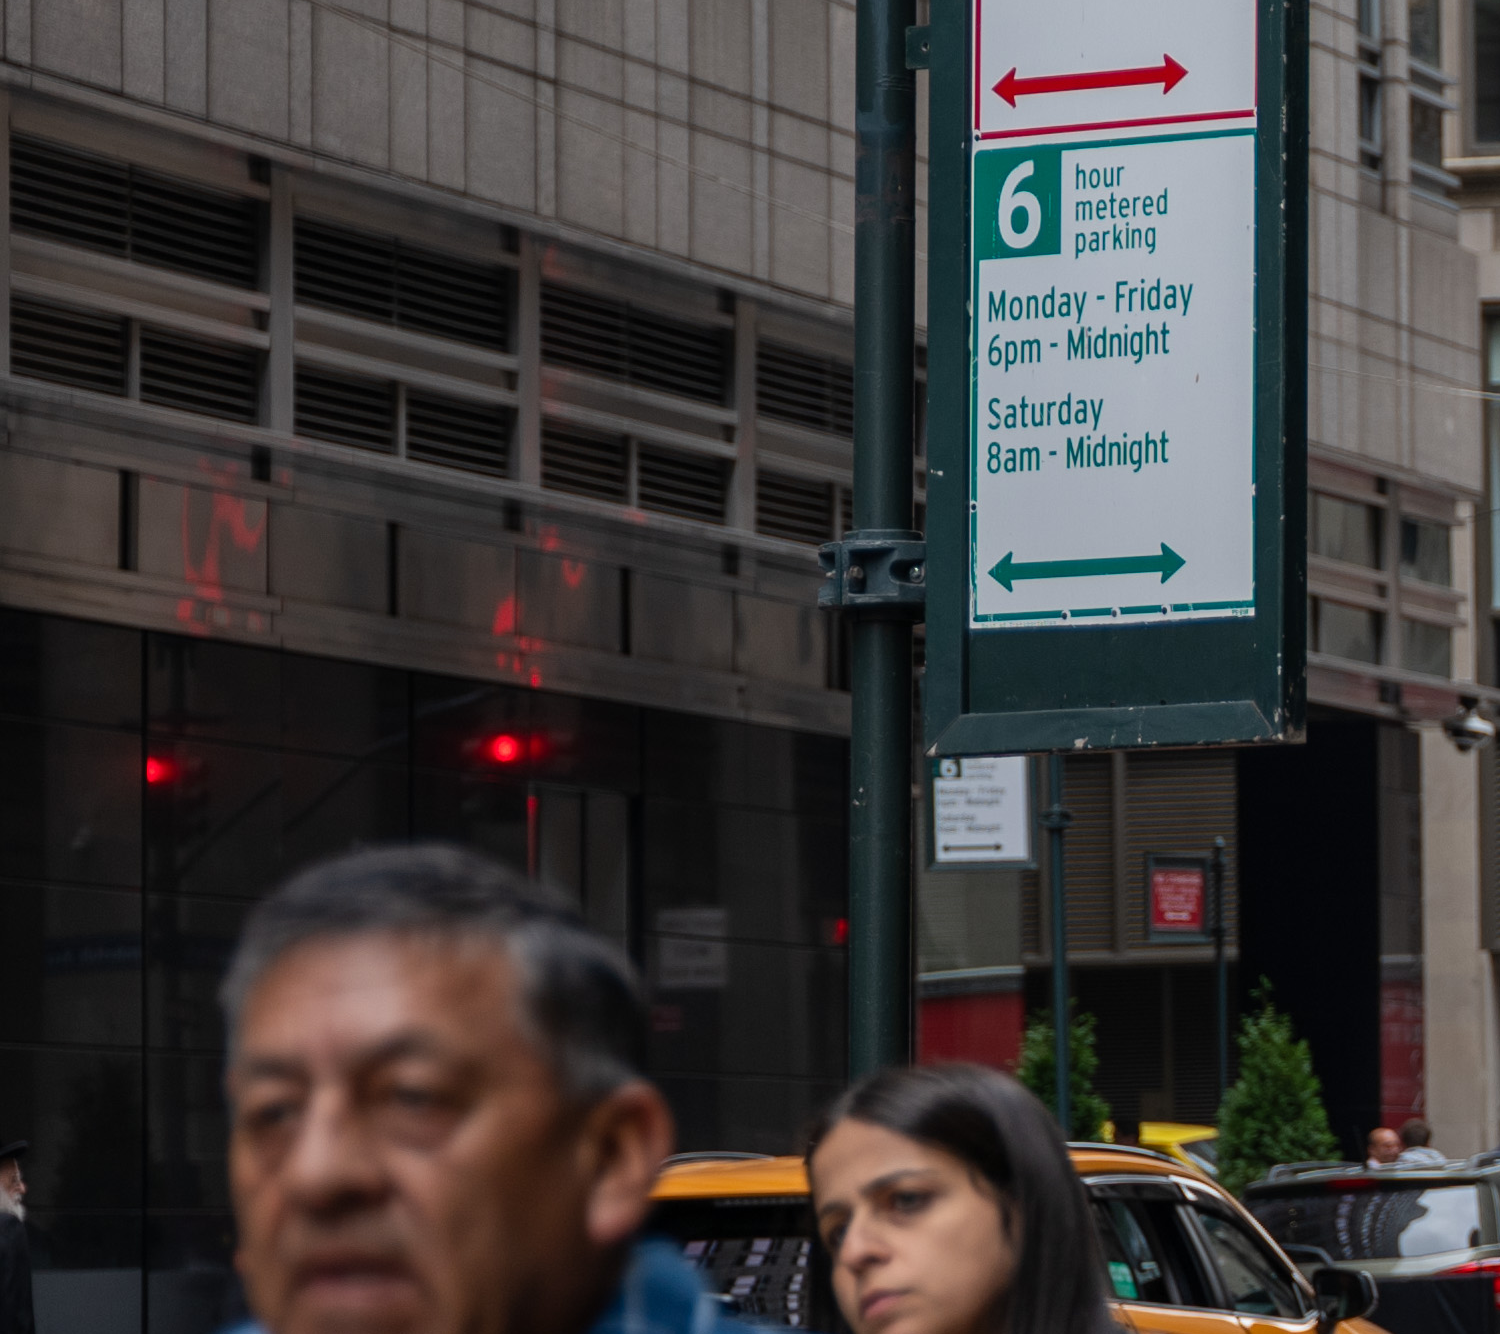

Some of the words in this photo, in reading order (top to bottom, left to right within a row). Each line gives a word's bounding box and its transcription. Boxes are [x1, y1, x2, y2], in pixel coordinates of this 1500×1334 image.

[1075, 163, 1124, 188] hour
[997, 160, 1042, 249] 6
[1074, 189, 1168, 218] metered
[1074, 221, 1157, 259] parking
[987, 286, 1086, 323] Monday
[1114, 278, 1193, 316] Friday
[987, 334, 1042, 369] 6pm
[1066, 323, 1170, 362] Midnight
[987, 394, 1104, 432] Saturday
[986, 441, 1041, 475] 8am
[1066, 429, 1170, 474] Midnight
